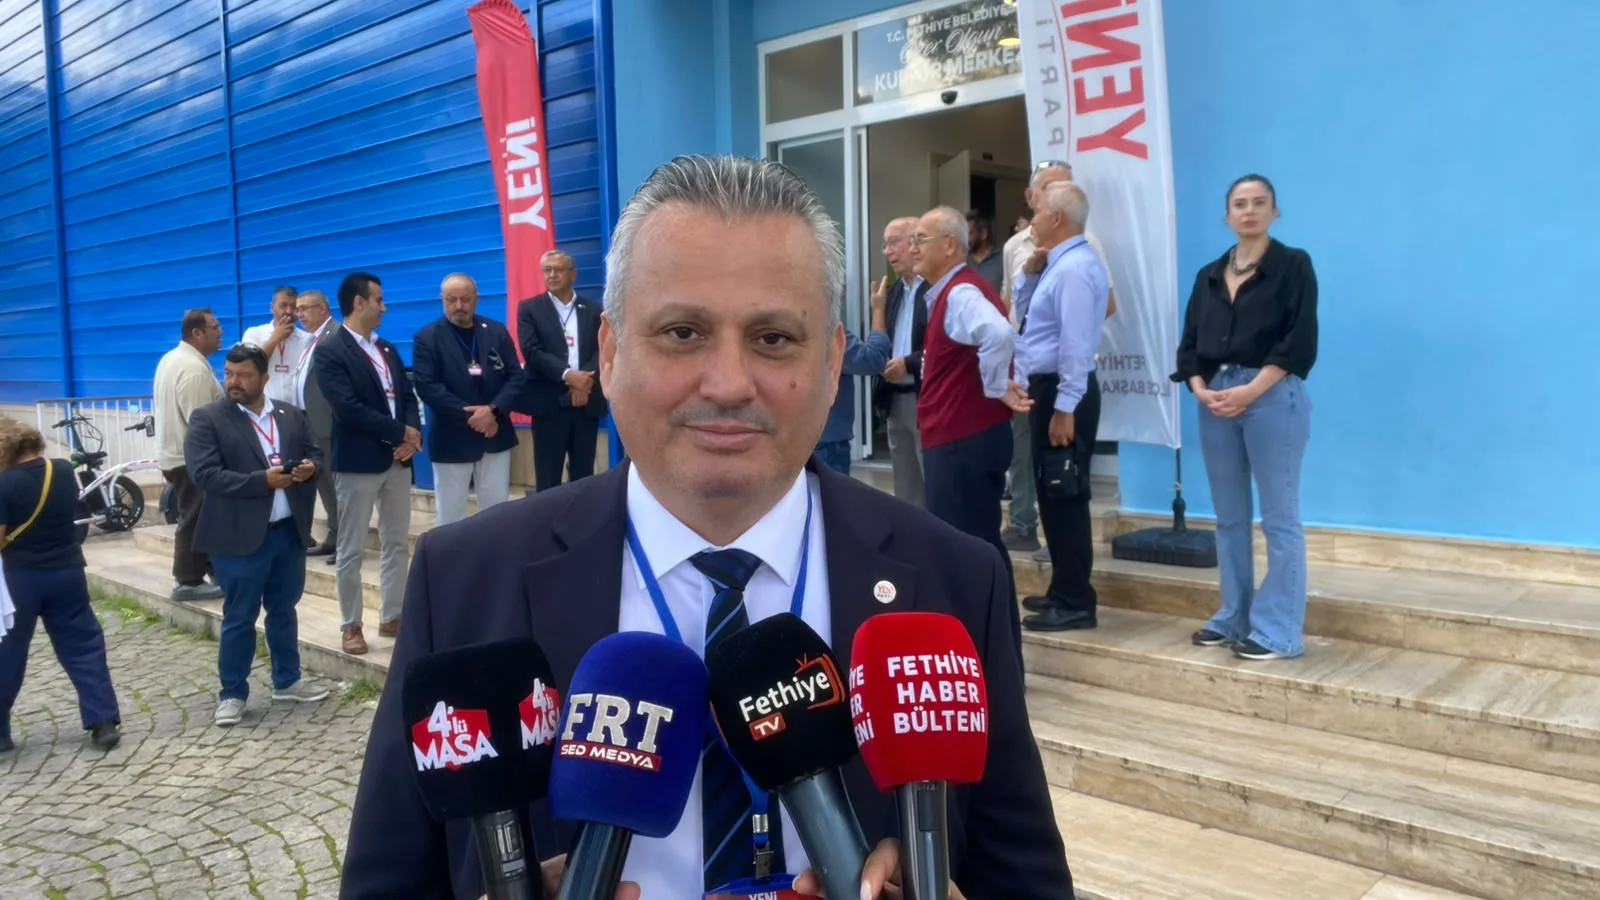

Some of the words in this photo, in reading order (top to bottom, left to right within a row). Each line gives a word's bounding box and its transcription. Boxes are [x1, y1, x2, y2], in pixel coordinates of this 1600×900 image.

[886, 30, 904, 43] T.C.
[887, 650, 980, 679] FETHİYE
[738, 670, 831, 722] Fethiye
[897, 681, 980, 705] HABER
[561, 693, 674, 753] FRT
[754, 716, 780, 737] TV
[893, 706, 985, 735] BÜLTENİ
[412, 729, 499, 771] MASA
[590, 747, 654, 769] MEDYA
